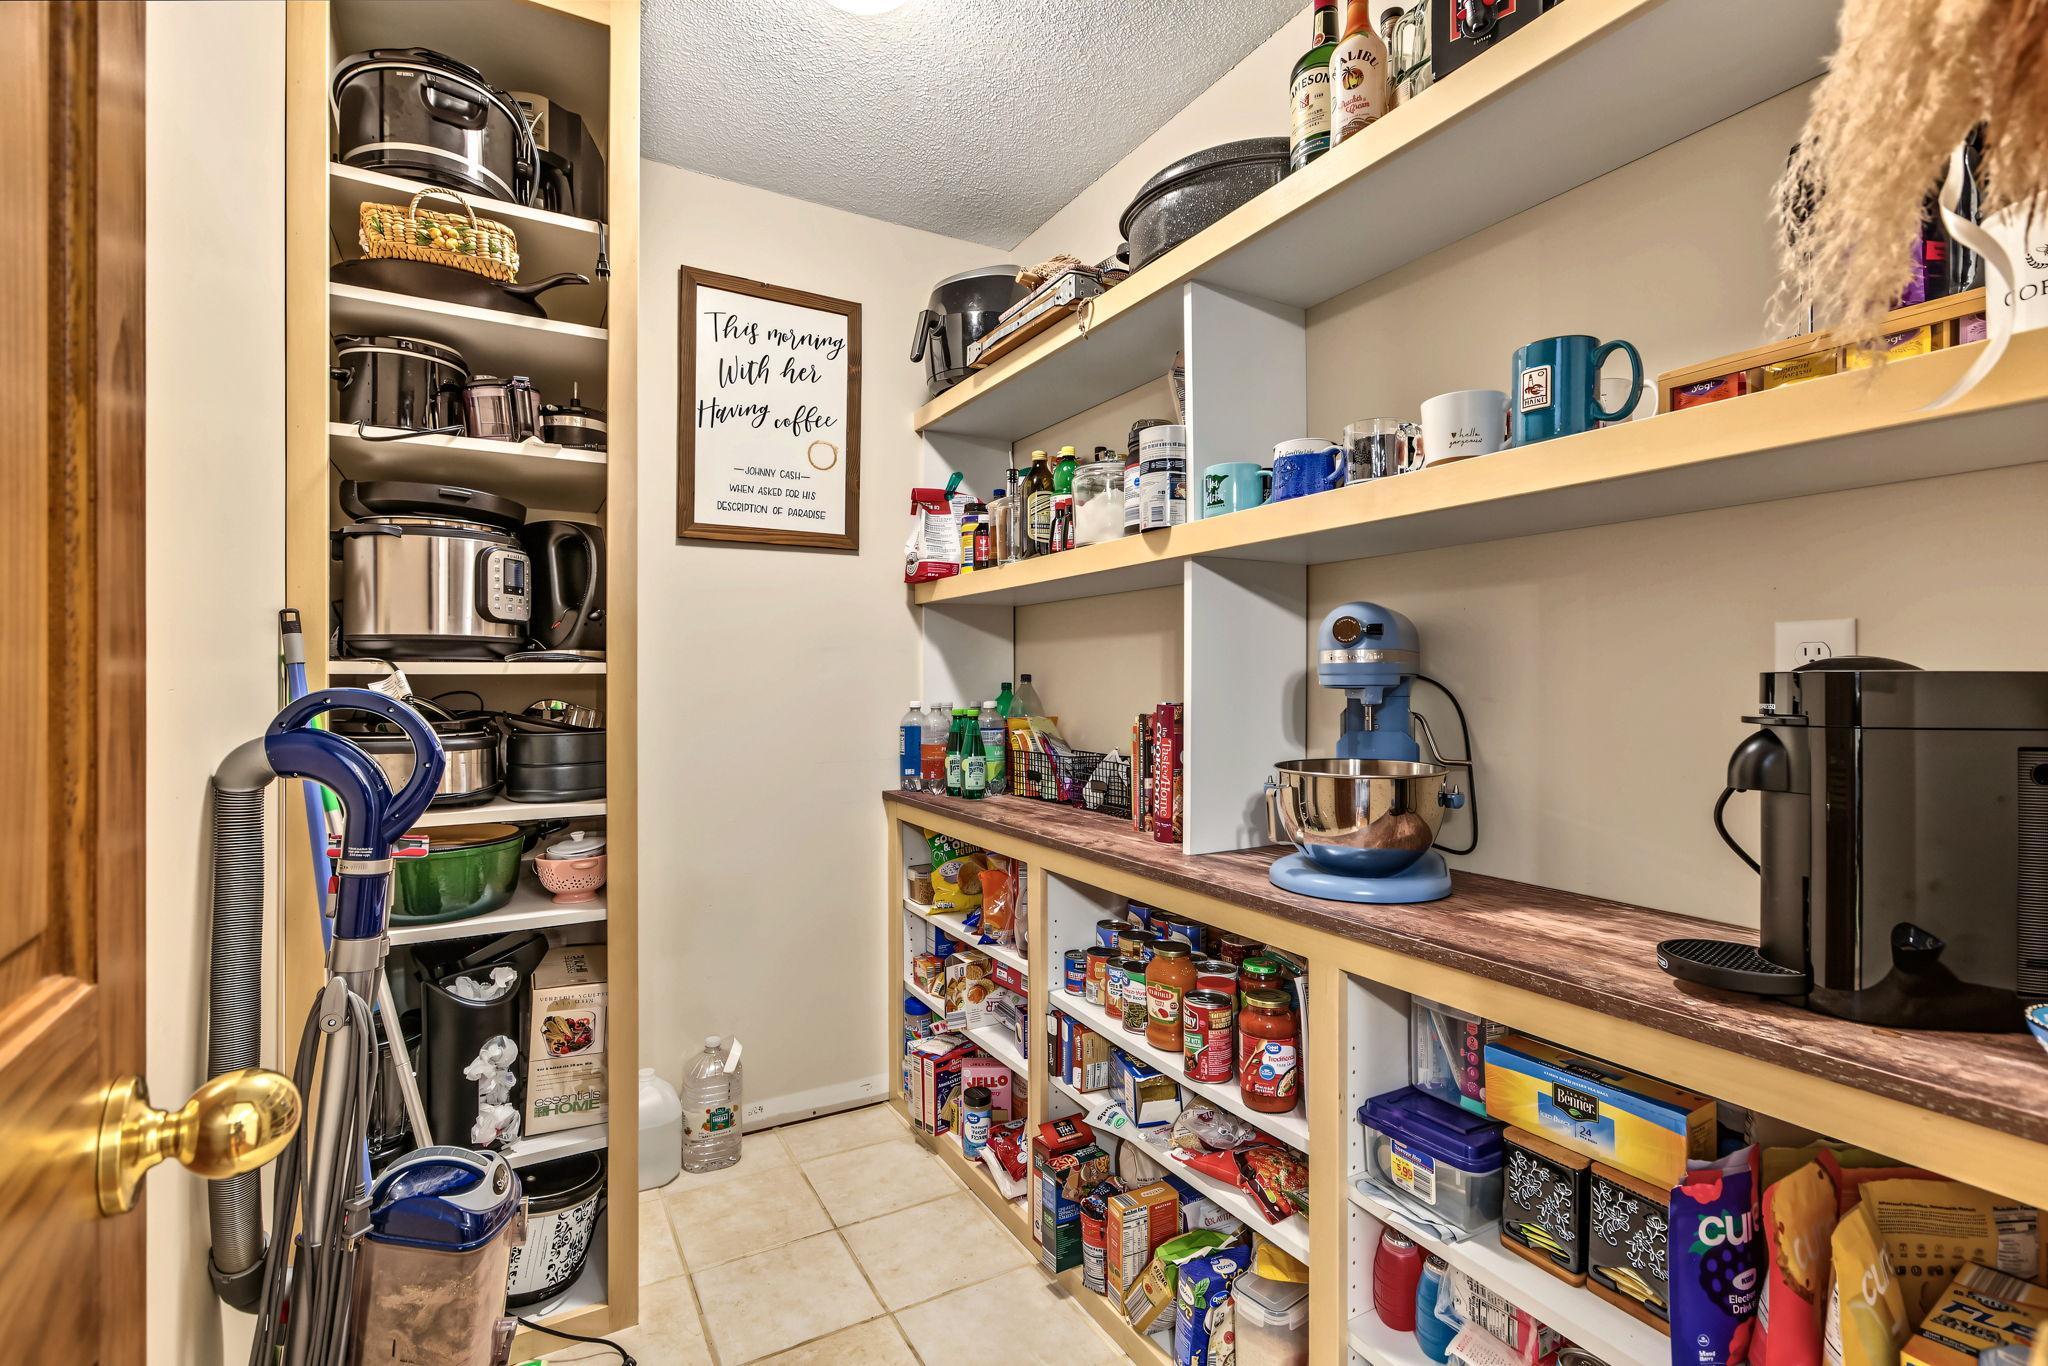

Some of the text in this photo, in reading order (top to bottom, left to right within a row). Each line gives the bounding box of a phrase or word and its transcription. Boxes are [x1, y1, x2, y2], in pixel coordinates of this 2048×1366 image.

[1338, 49, 1379, 71] ALIBU
[1291, 73, 1330, 98] AMESON
[704, 311, 846, 361] This morning
[719, 354, 822, 389] With her
[697, 397, 838, 437] Having coffee
[1459, 428, 1480, 438] hello
[729, 484, 817, 501] WHEN ASKED FOR HIS
[717, 501, 827, 520] DESCRIPTION OF PARADISE
[1154, 721, 1162, 816] COOKBOOK
[1161, 740, 1172, 772] Taste
[1161, 776, 1172, 817] Home
[535, 1089, 601, 1108] essentials
[549, 1099, 600, 1115] HOME
[1557, 1088, 1593, 1114] Benner
[1580, 1126, 1592, 1137] 24
